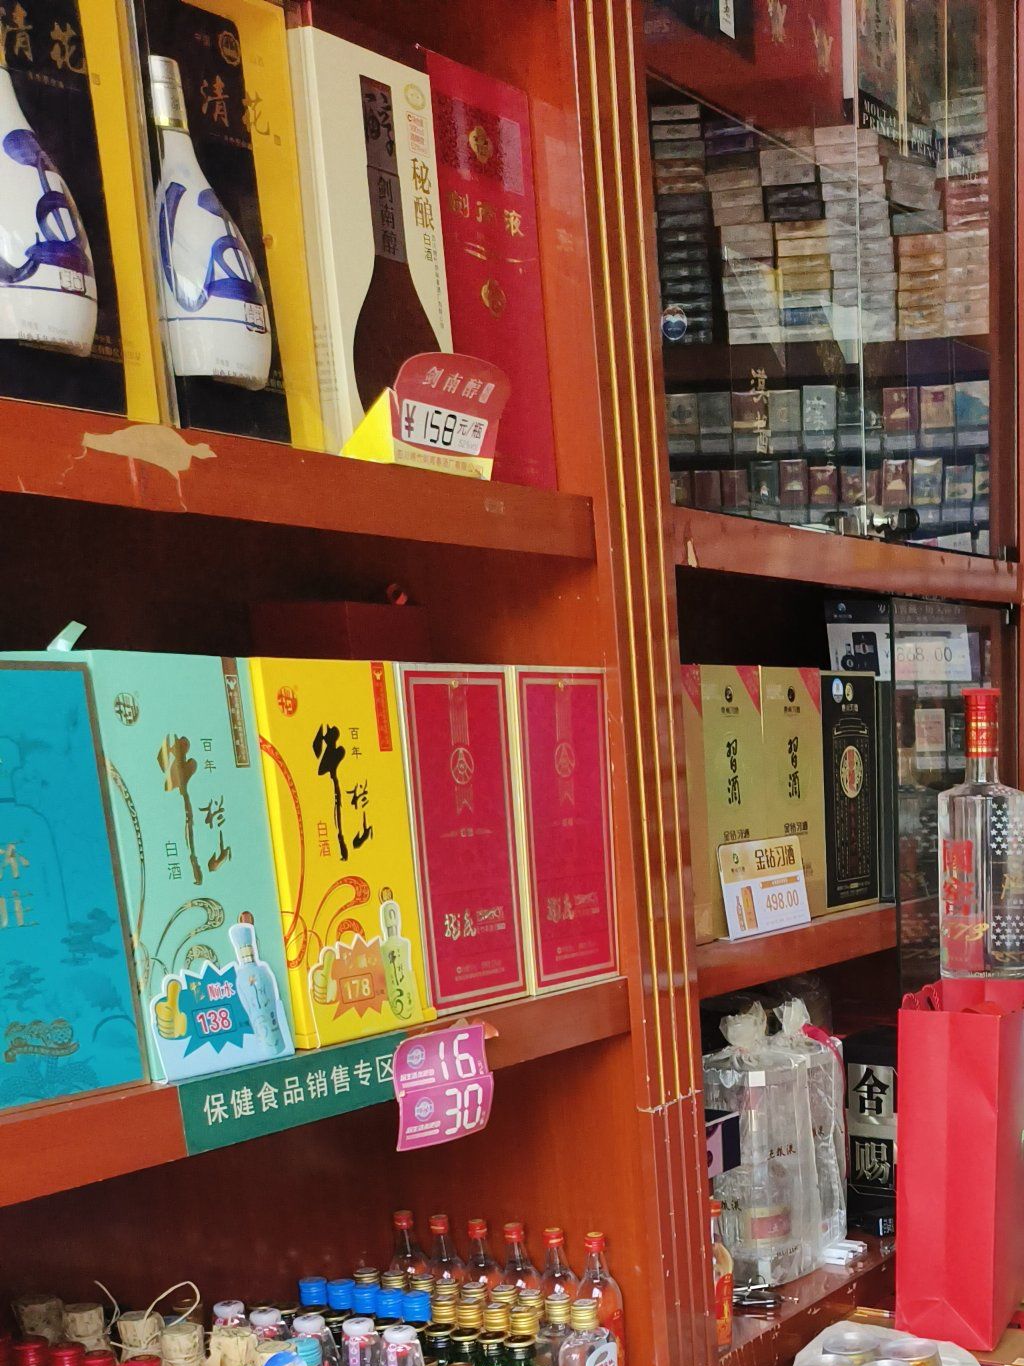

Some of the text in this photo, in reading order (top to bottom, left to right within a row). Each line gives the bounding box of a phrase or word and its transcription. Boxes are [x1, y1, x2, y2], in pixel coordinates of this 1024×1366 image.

[411, 158, 434, 231] 秘酿
[200, 737, 217, 773] 百年
[348, 727, 362, 759] 百年
[317, 821, 331, 857] 白酒
[165, 840, 182, 881] 白酒
[755, 845, 796, 871] 金钻习酒
[766, 889, 799, 912] 498.00
[344, 978, 371, 1000] 178
[197, 1008, 231, 1034] 138
[439, 1033, 477, 1080] 16
[203, 1054, 395, 1126] 保健食品销售专区
[445, 1083, 483, 1135] 30
